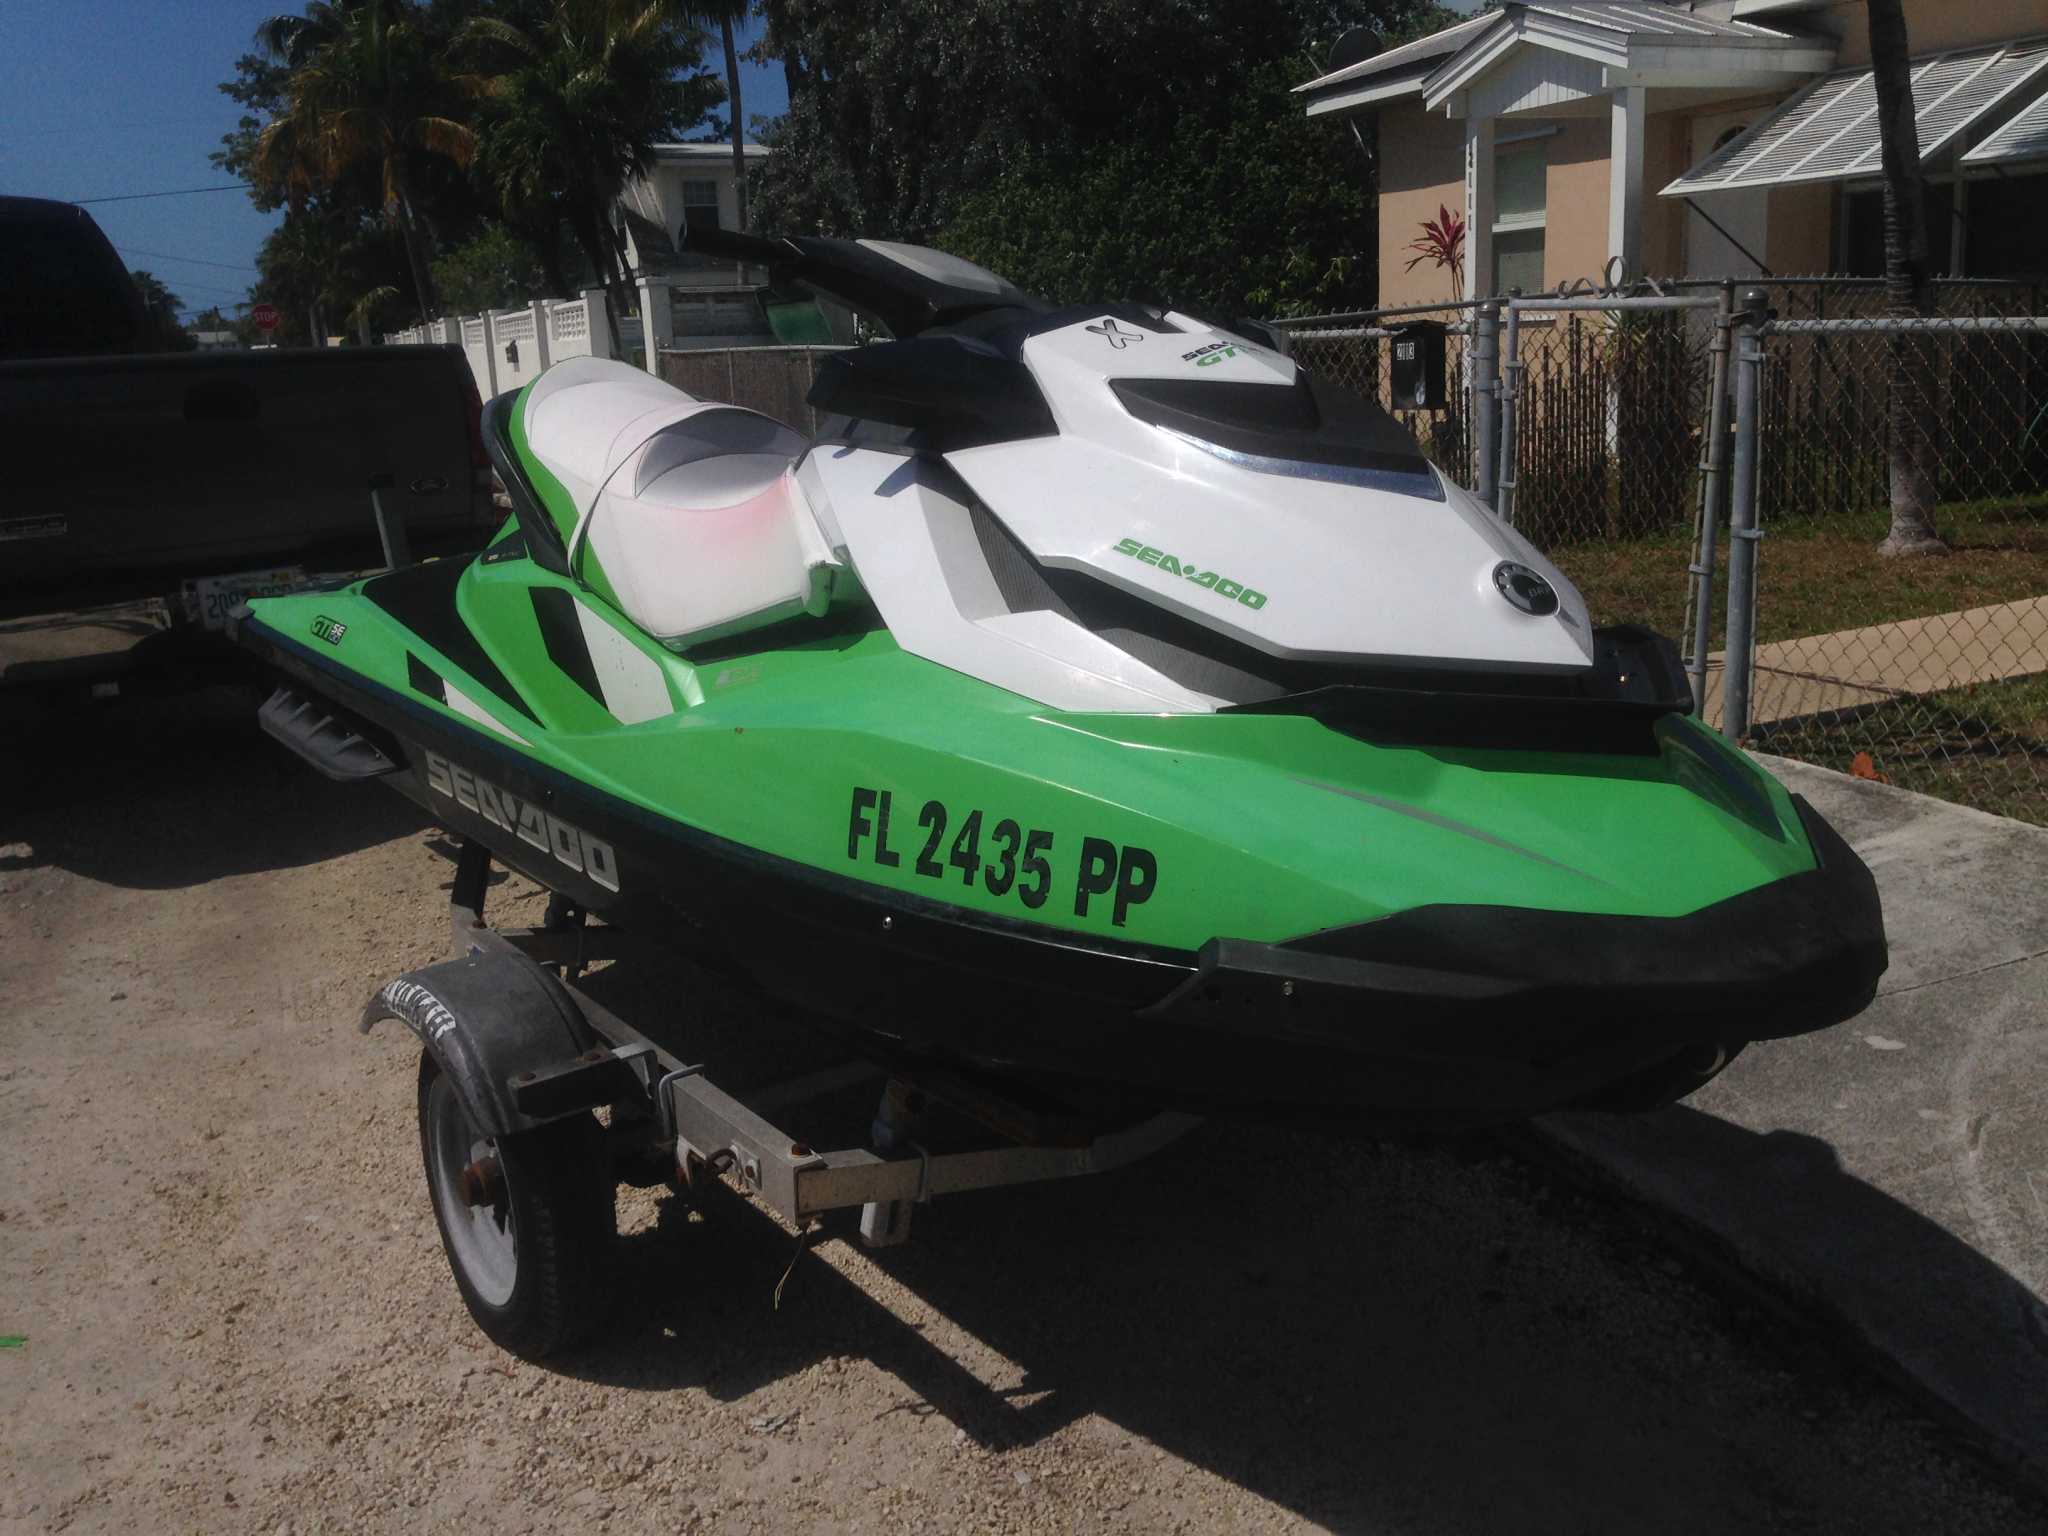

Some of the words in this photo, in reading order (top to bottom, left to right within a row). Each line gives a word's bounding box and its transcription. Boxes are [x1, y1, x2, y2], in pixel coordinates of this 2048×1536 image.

[848, 787, 900, 868] FL
[915, 800, 1054, 910] 2435
[1074, 836, 1157, 928] PP
